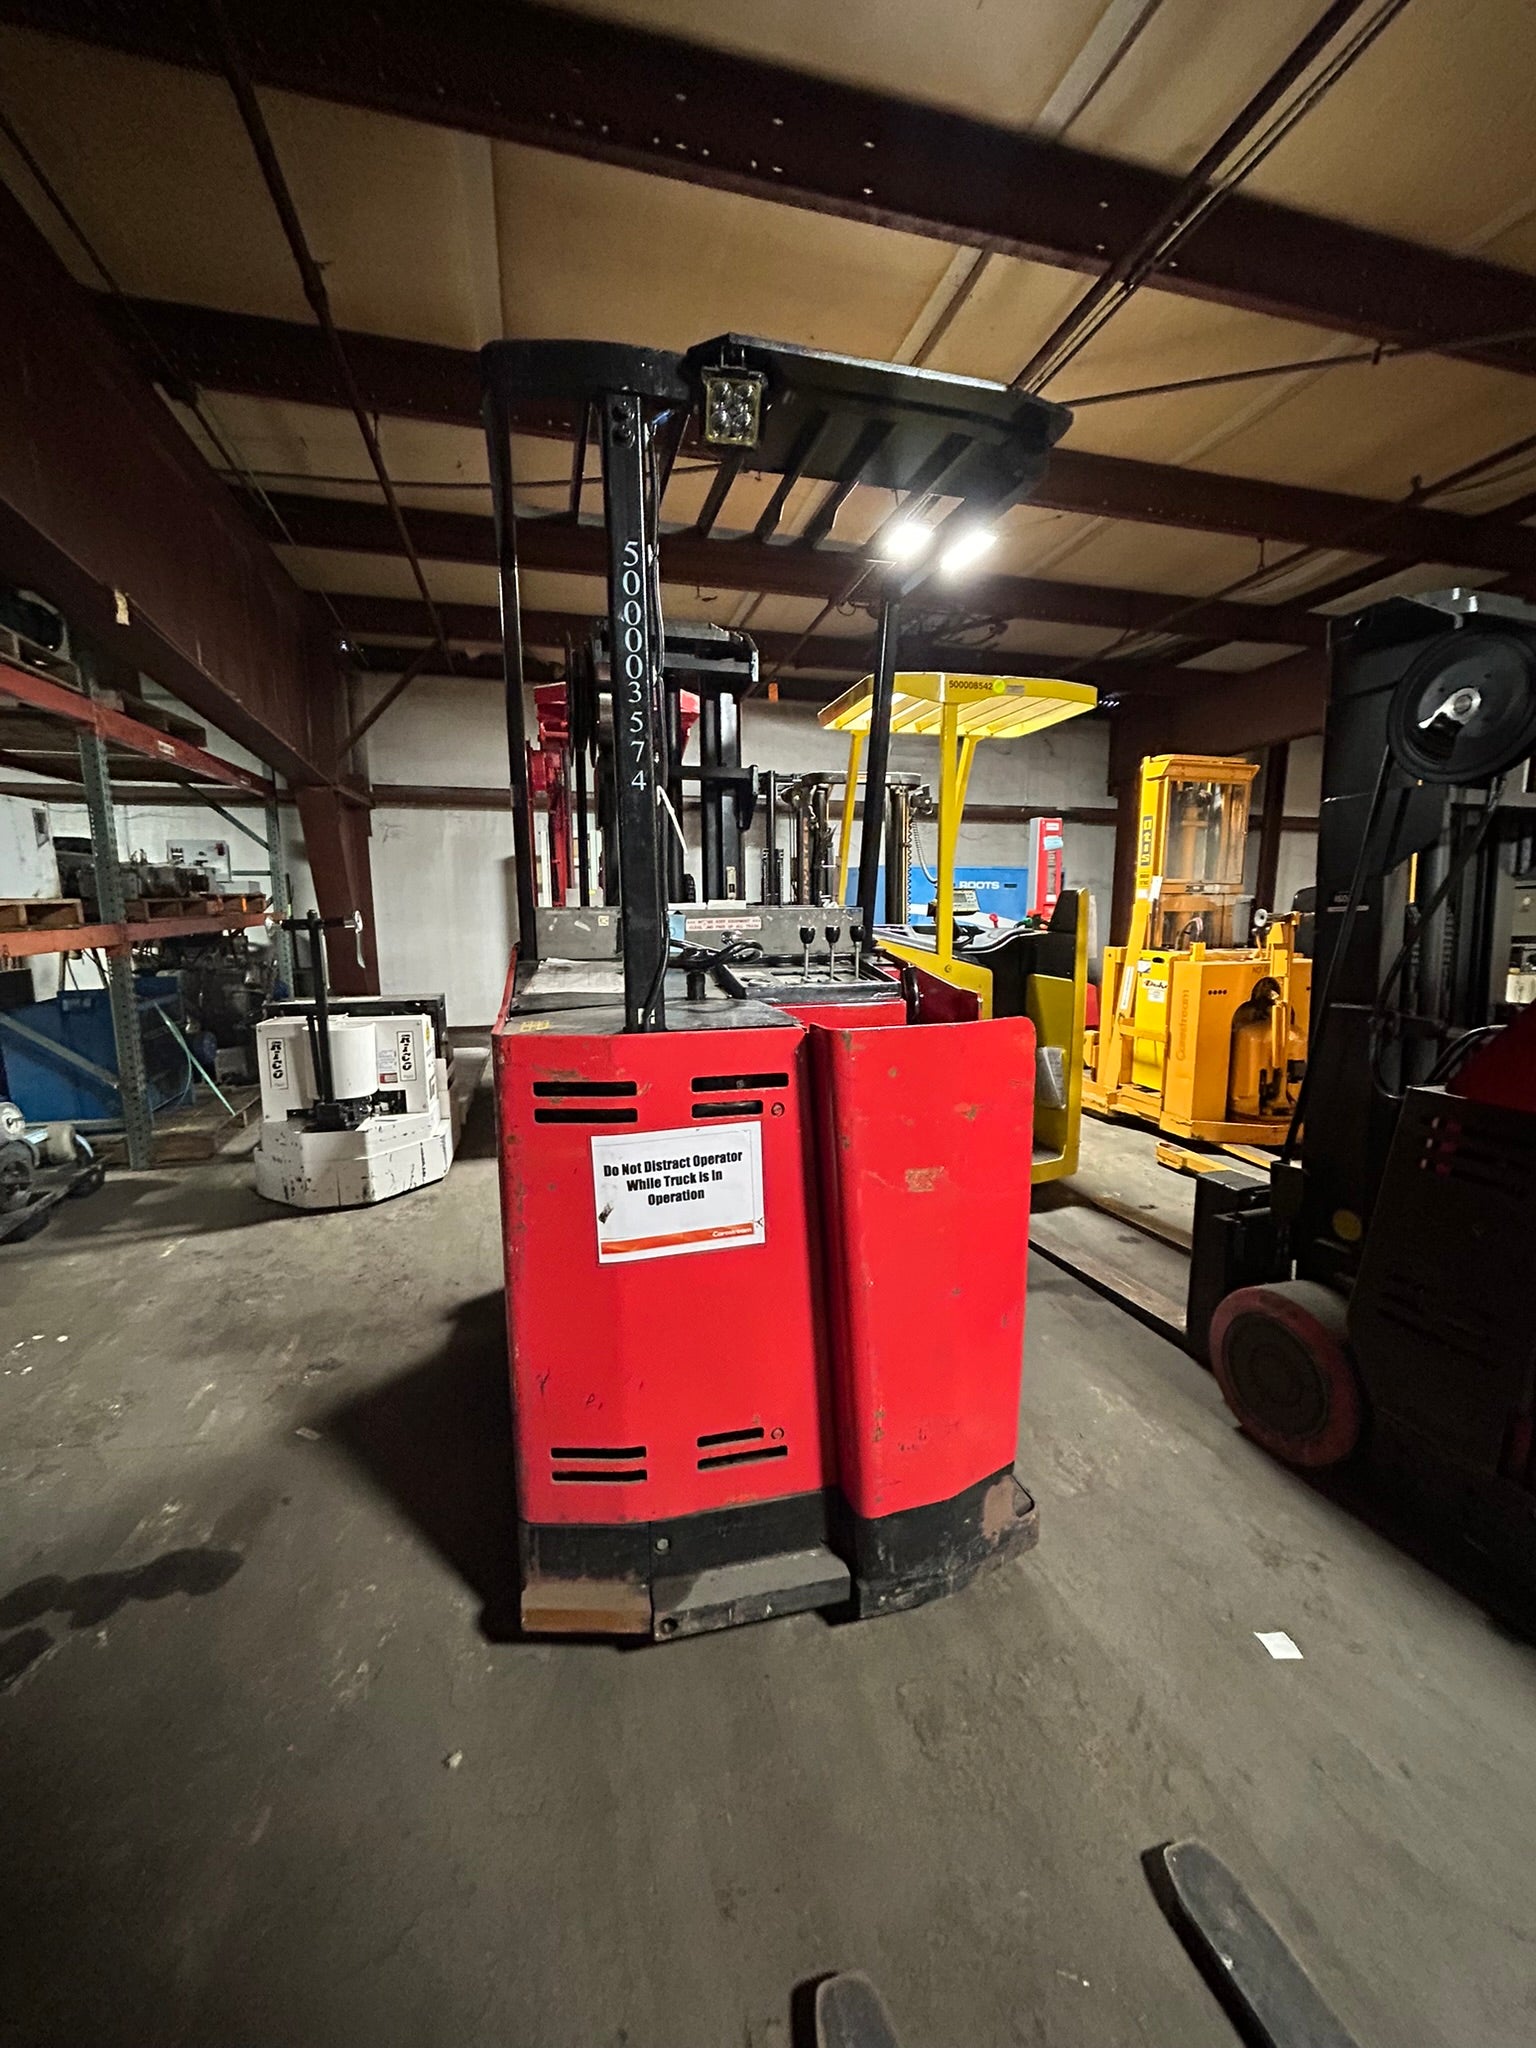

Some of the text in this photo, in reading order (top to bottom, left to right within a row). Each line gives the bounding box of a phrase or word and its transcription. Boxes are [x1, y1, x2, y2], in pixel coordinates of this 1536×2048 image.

[622, 540, 647, 791] 500003574
[948, 680, 993, 690] 500008542
[603, 1151, 743, 1177] Do Not Distract Operator
[626, 1177, 662, 1192] While
[663, 1172, 697, 1188] Truck
[647, 1189, 705, 1206] Operation
